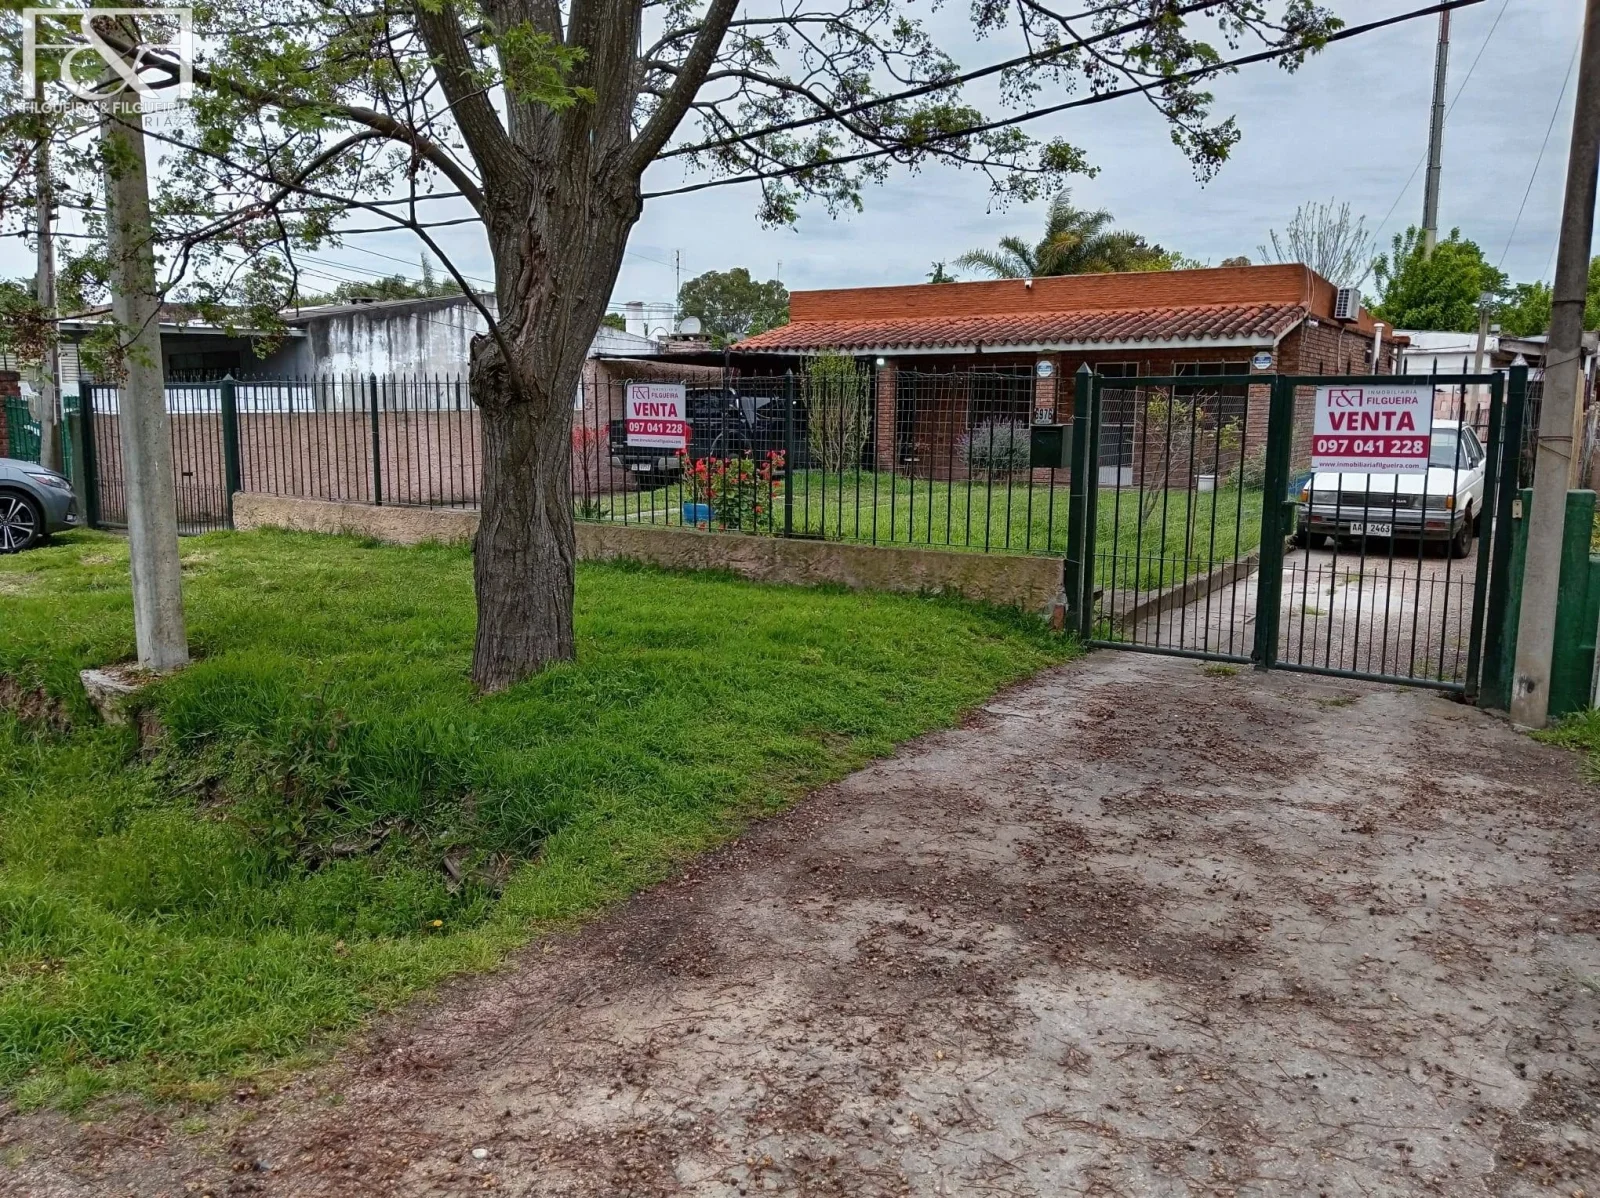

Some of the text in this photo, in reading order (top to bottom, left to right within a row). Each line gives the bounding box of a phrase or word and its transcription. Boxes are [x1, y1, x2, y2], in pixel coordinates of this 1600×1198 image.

[1366, 396, 1418, 404] FILGUEIRA
[633, 402, 678, 417] VENTA
[1328, 411, 1415, 431] VENTA
[629, 422, 683, 434] 097 041 228
[1317, 439, 1424, 454] 097 041 228
[1319, 462, 1420, 470] www.inmobiliariafilgueira.com
[1352, 523, 1391, 533] AA 2463
